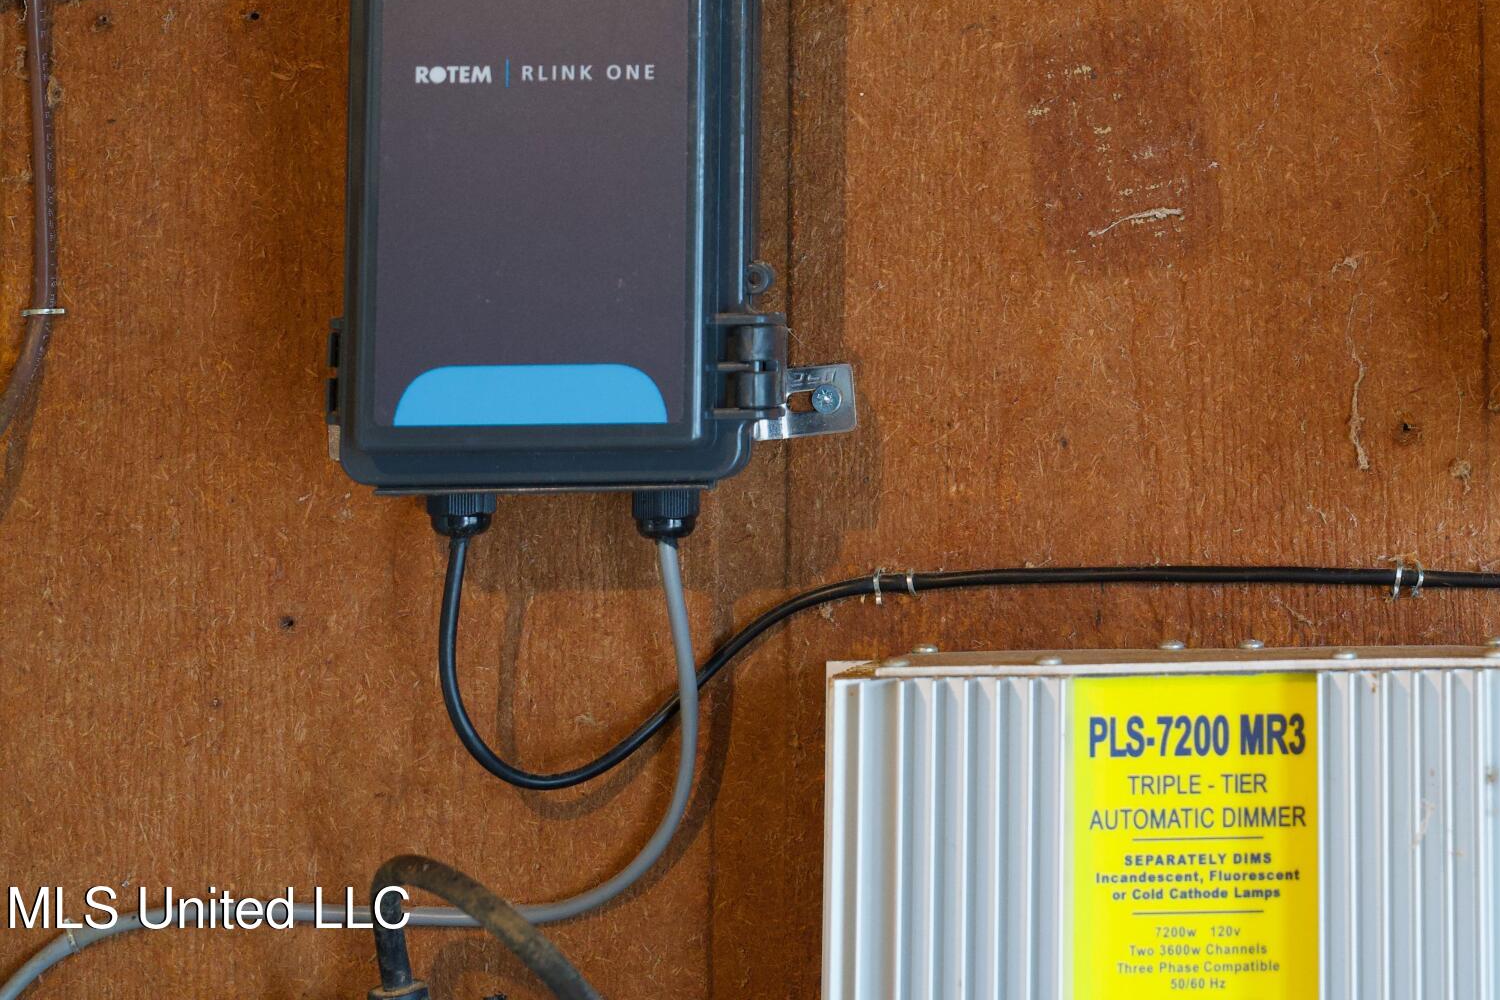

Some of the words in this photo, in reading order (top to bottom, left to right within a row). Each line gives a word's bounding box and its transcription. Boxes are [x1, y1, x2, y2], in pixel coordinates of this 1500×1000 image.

[415, 66, 492, 84] ROTEM
[521, 64, 593, 81] RLINK
[606, 63, 656, 80] ONE
[1089, 715, 1230, 758] PLS-7200
[1239, 713, 1307, 756] MR3
[1128, 774, 1202, 796] TRIPLE
[1220, 773, 1268, 794] TIER
[1089, 808, 1215, 830] AUTOMATIC
[1222, 806, 1307, 828] DIMMER
[1124, 853, 1226, 867] SEPARATELY
[1233, 852, 1272, 865] DIMS
[1096, 870, 1204, 884] Incandescent,
[1209, 869, 1300, 882] Fluorescent
[1112, 890, 1127, 901] or
[1132, 888, 1164, 901] Cold
[1169, 887, 1228, 900] Cathode
[1234, 887, 1281, 901] Lamps
[1155, 926, 1197, 938] 7200w
[1210, 925, 1241, 937] 120v
[1129, 945, 1154, 957] Two
[1159, 944, 1201, 956] 3600w
[1205, 943, 1268, 956] Channels
[1117, 962, 1154, 974] Three
[1158, 961, 1200, 974] Phase
[1203, 960, 1280, 975] Compatible
[1171, 978, 1205, 990] 50/60
[1210, 978, 1226, 990] Hz
